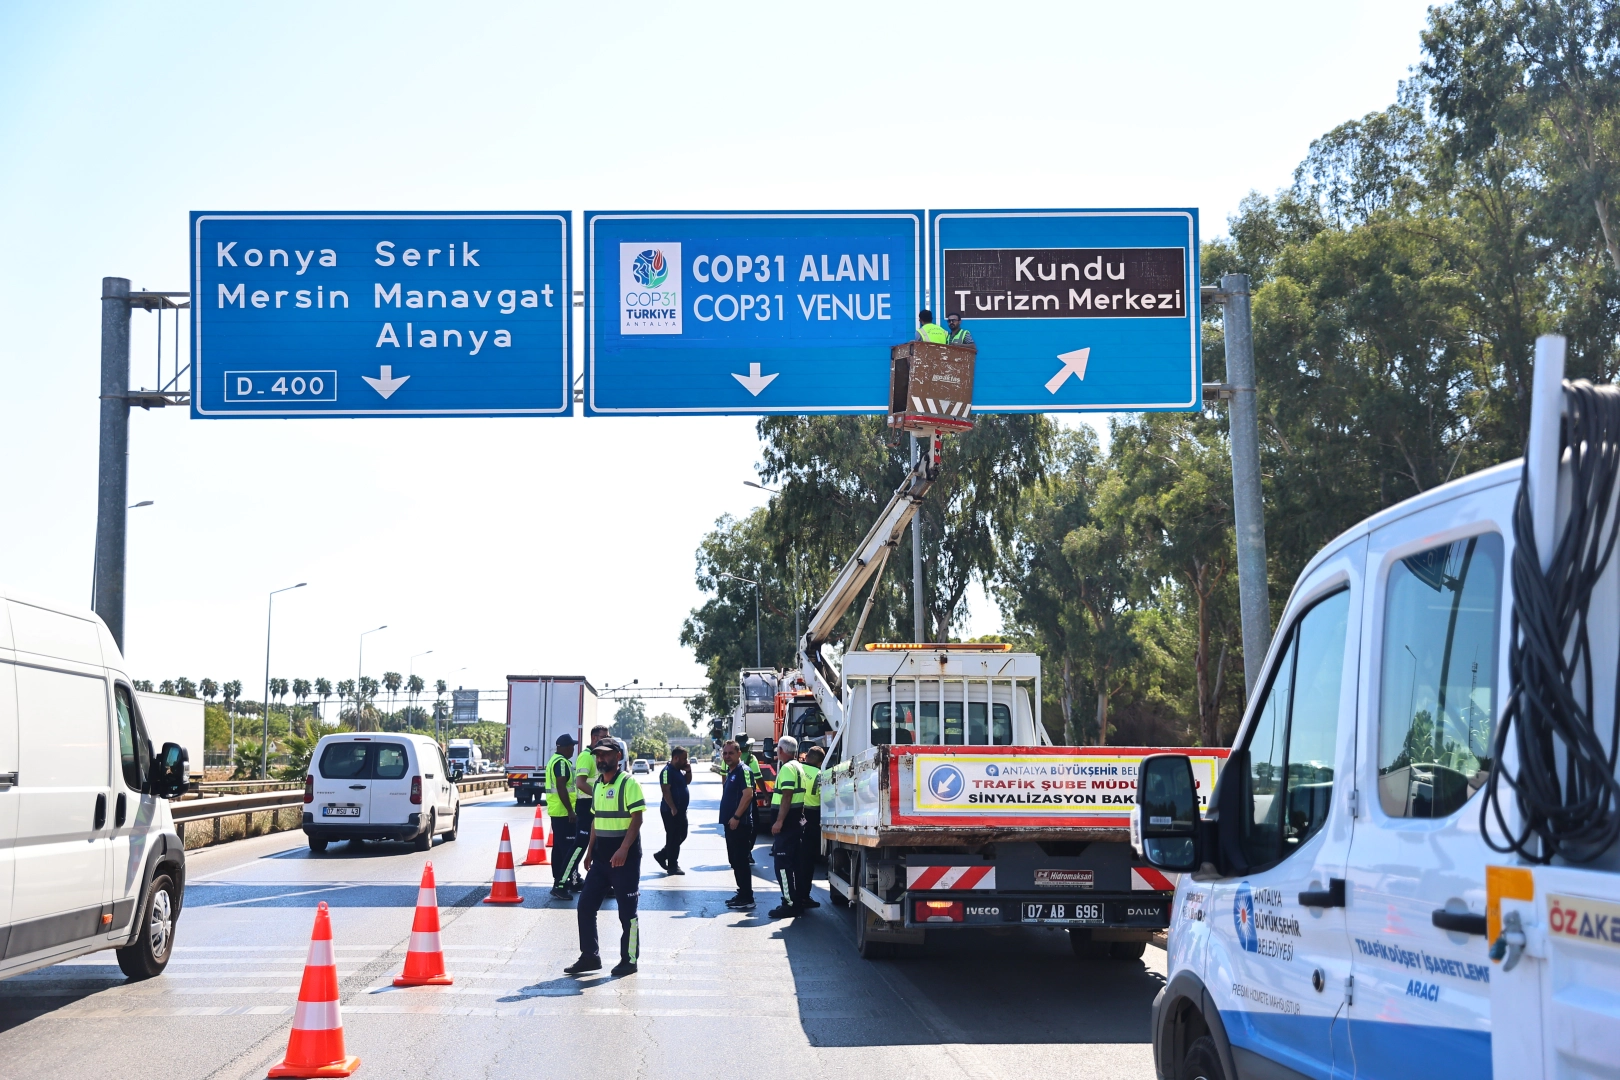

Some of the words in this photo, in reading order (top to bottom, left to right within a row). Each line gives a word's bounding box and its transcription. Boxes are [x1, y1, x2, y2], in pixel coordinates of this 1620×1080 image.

[218, 242, 337, 275] Konya
[375, 241, 480, 266] Serik
[693, 254, 784, 283] COP31
[799, 254, 890, 281] ALANI
[1015, 256, 1124, 282] Kundu
[218, 284, 349, 309] Mersin
[374, 283, 554, 314] Manavgat
[626, 292, 676, 306] COP31
[694, 294, 784, 322] COP31
[797, 294, 891, 320] VENUE
[955, 290, 1060, 312] Turizm
[1069, 288, 1181, 310] Merkezi
[376, 322, 512, 355] Alanya
[1002, 766, 1047, 776] ANTALYA
[1050, 764, 1118, 778] BÜYÜKŞEHİR
[972, 779, 1036, 789] TRAFİK
[1041, 780, 1087, 791] ŞUBE
[968, 792, 1096, 804] SİNYALİZASYON
[350, 806, 359, 815] 43
[1049, 871, 1092, 880] Hidromaksan
[1254, 889, 1282, 907] ANTALYA
[966, 907, 1000, 915] IVECO
[1028, 905, 1043, 918] 07
[1050, 905, 1065, 918] AB
[1075, 905, 1099, 918] 696
[1127, 908, 1160, 916] DAILY
[1255, 909, 1301, 938] BÜYÜKŞEHİR
[1257, 938, 1294, 961] BELEDİYESİ
[1355, 938, 1389, 960] TRAFİK
[1388, 944, 1421, 969] DÜŞEY
[1406, 979, 1439, 1002] ARACI
